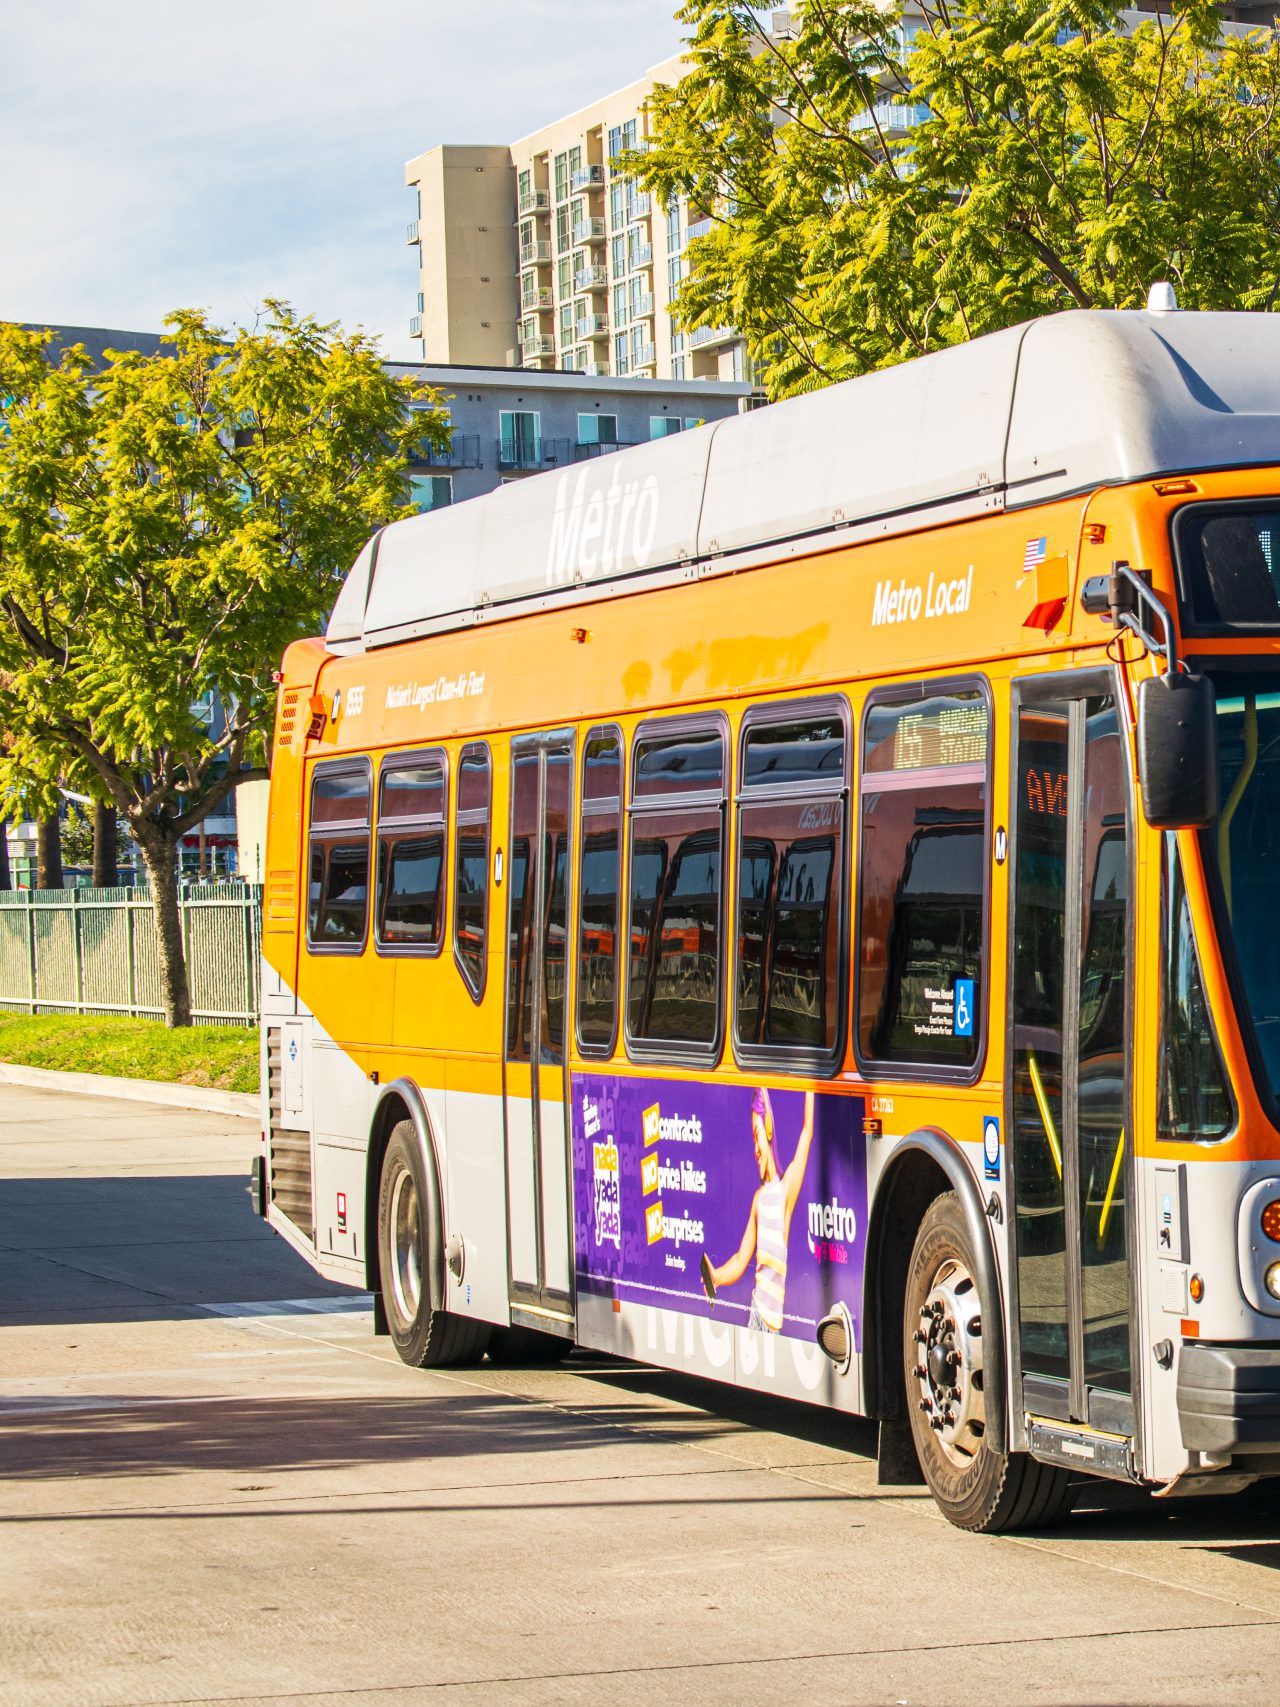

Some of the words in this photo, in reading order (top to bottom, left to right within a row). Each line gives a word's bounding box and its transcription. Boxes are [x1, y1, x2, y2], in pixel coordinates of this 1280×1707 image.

[545, 460, 659, 585] Metro
[871, 579, 923, 626] Metro
[924, 564, 974, 618] Local
[345, 686, 366, 716] 1555
[412, 680, 437, 712] Largest
[466, 672, 486, 696] Fleet
[644, 1111, 659, 1141] NO
[659, 1113, 702, 1143] contracts
[592, 1134, 619, 1172] nada
[595, 1172, 619, 1208] yada
[642, 1160, 656, 1189] NO
[657, 1158, 681, 1196] price
[681, 1160, 707, 1194] hikes
[596, 1200, 620, 1240] yada
[647, 1208, 660, 1238] NO
[661, 1209, 705, 1249] surprises
[808, 1197, 857, 1244] metro
